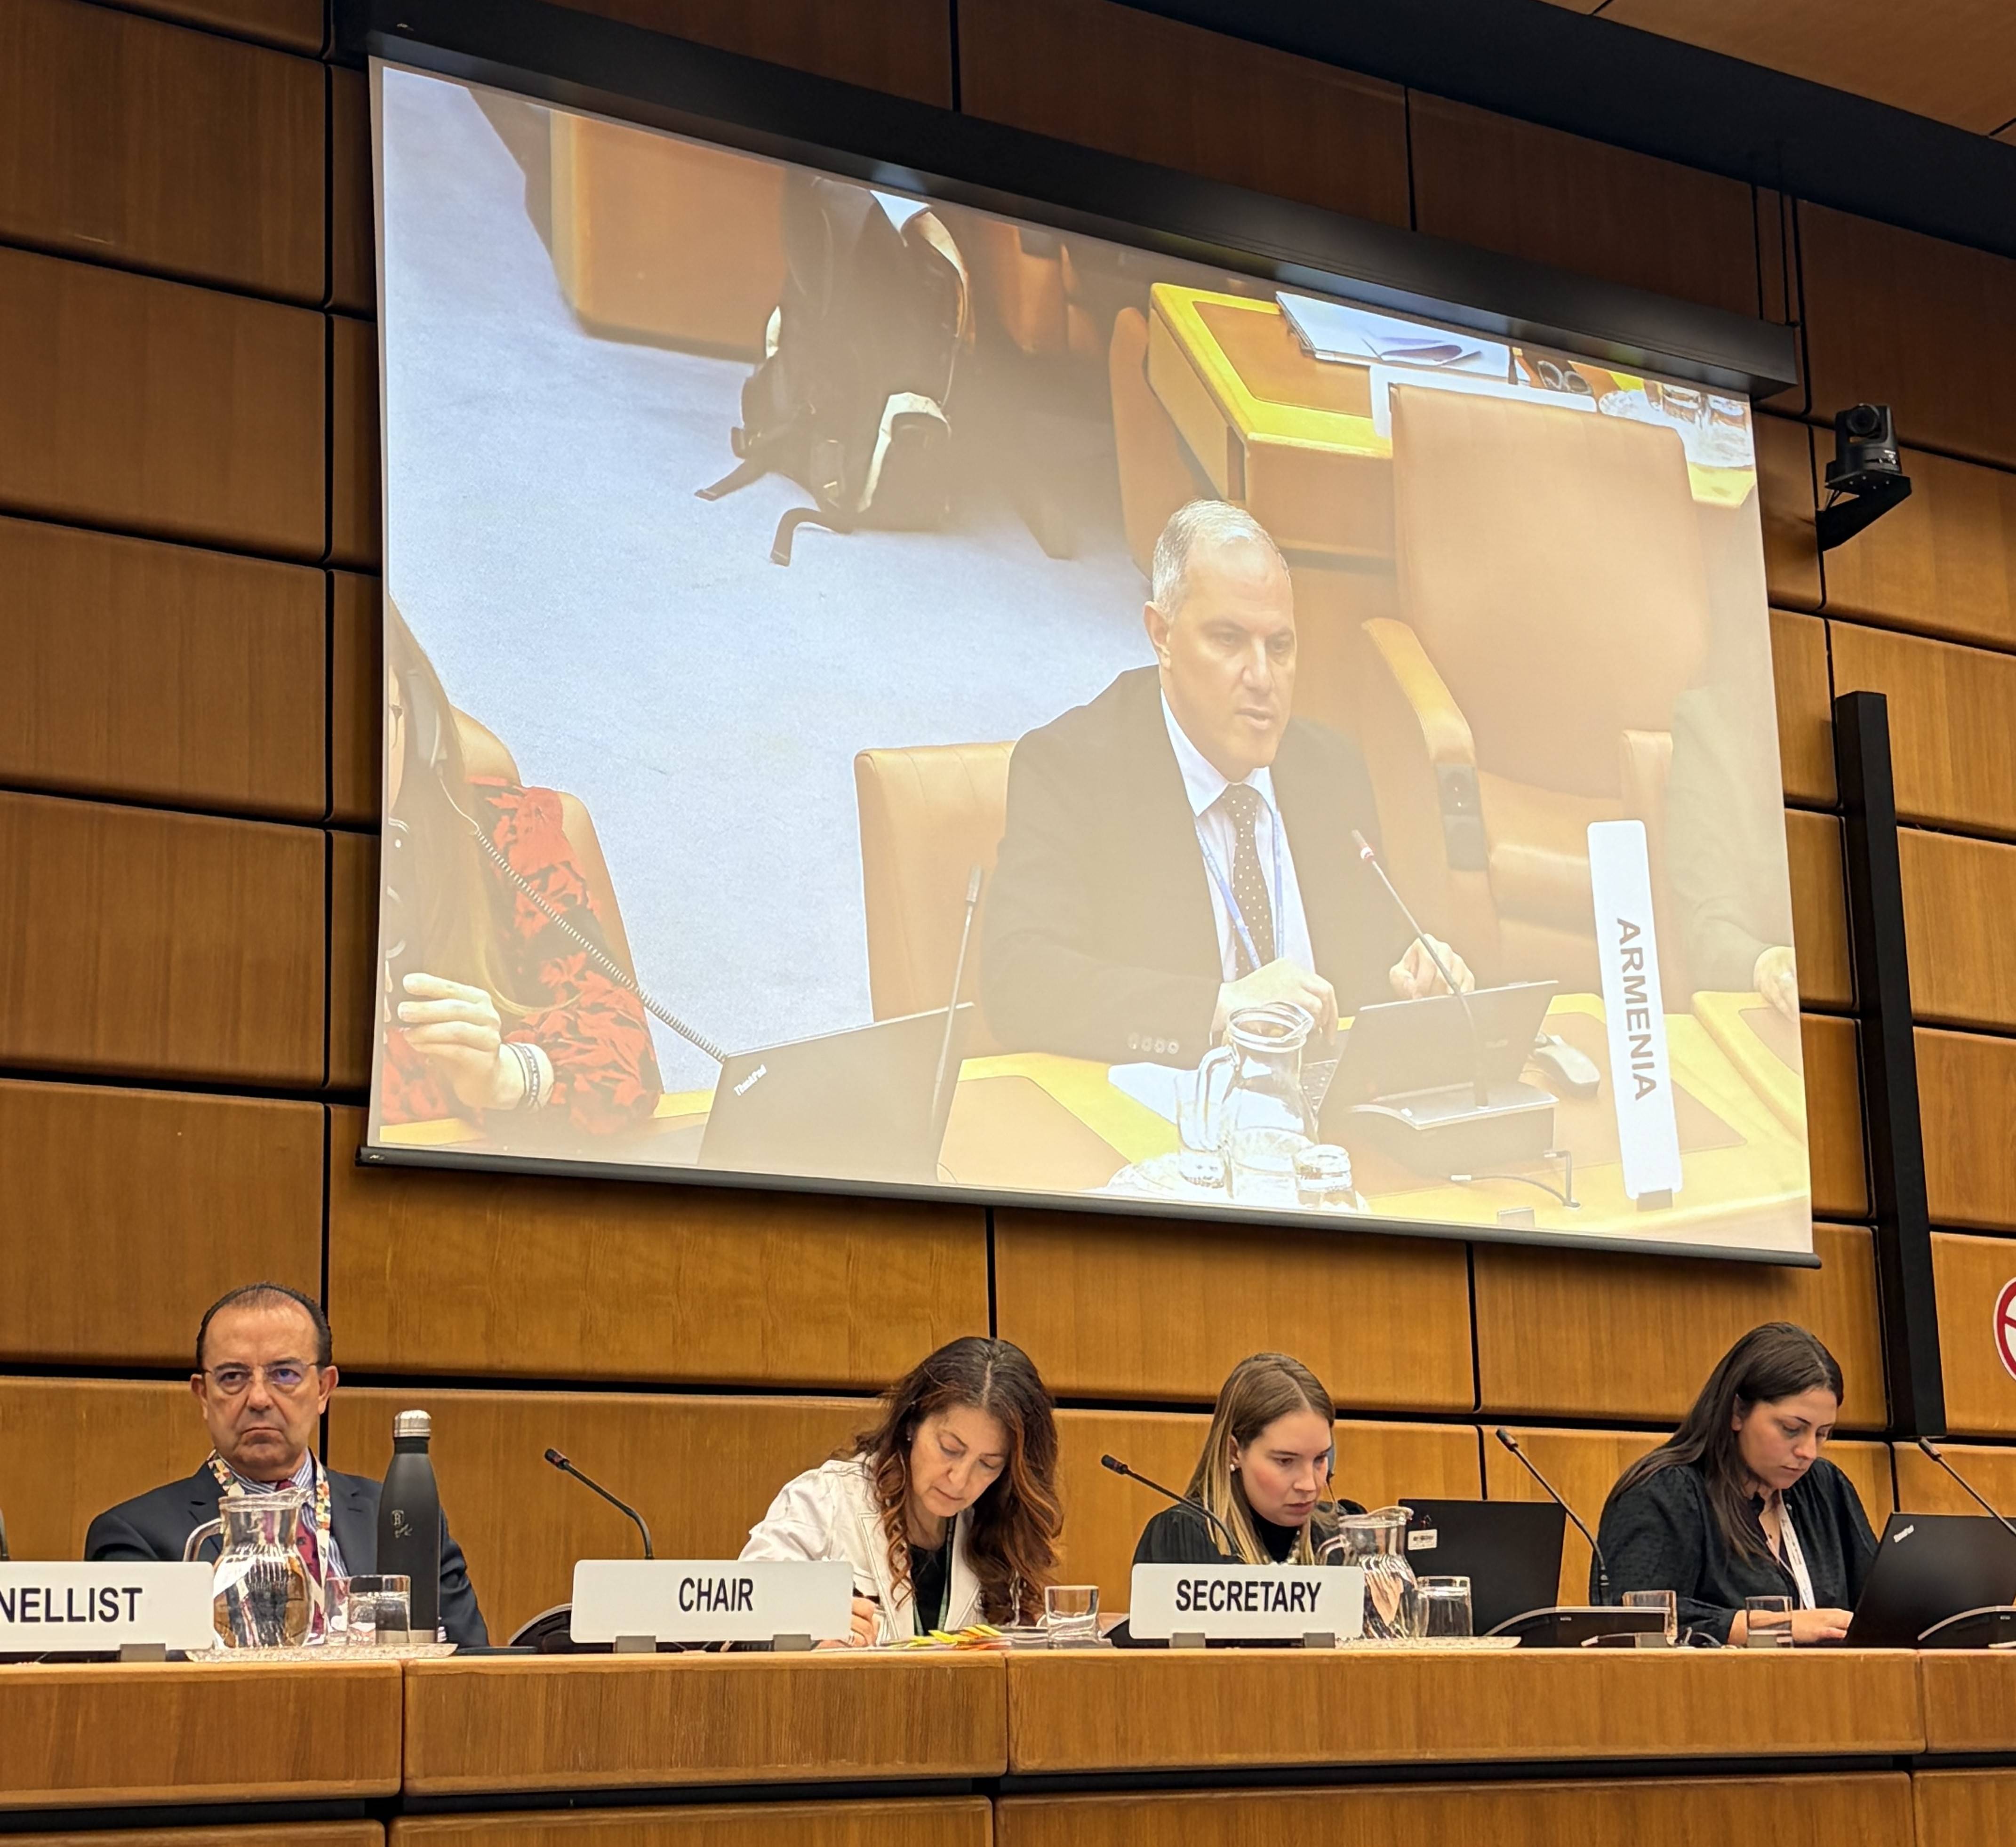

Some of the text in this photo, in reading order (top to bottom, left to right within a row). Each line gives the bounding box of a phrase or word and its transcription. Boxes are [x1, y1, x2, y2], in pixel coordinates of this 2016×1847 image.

[1616, 917, 1657, 1101] ARMENIA
[0, 1587, 143, 1623] NELLIST
[679, 1577, 754, 1612] CHAIR
[1175, 1579, 1322, 1613] SECRETARY
